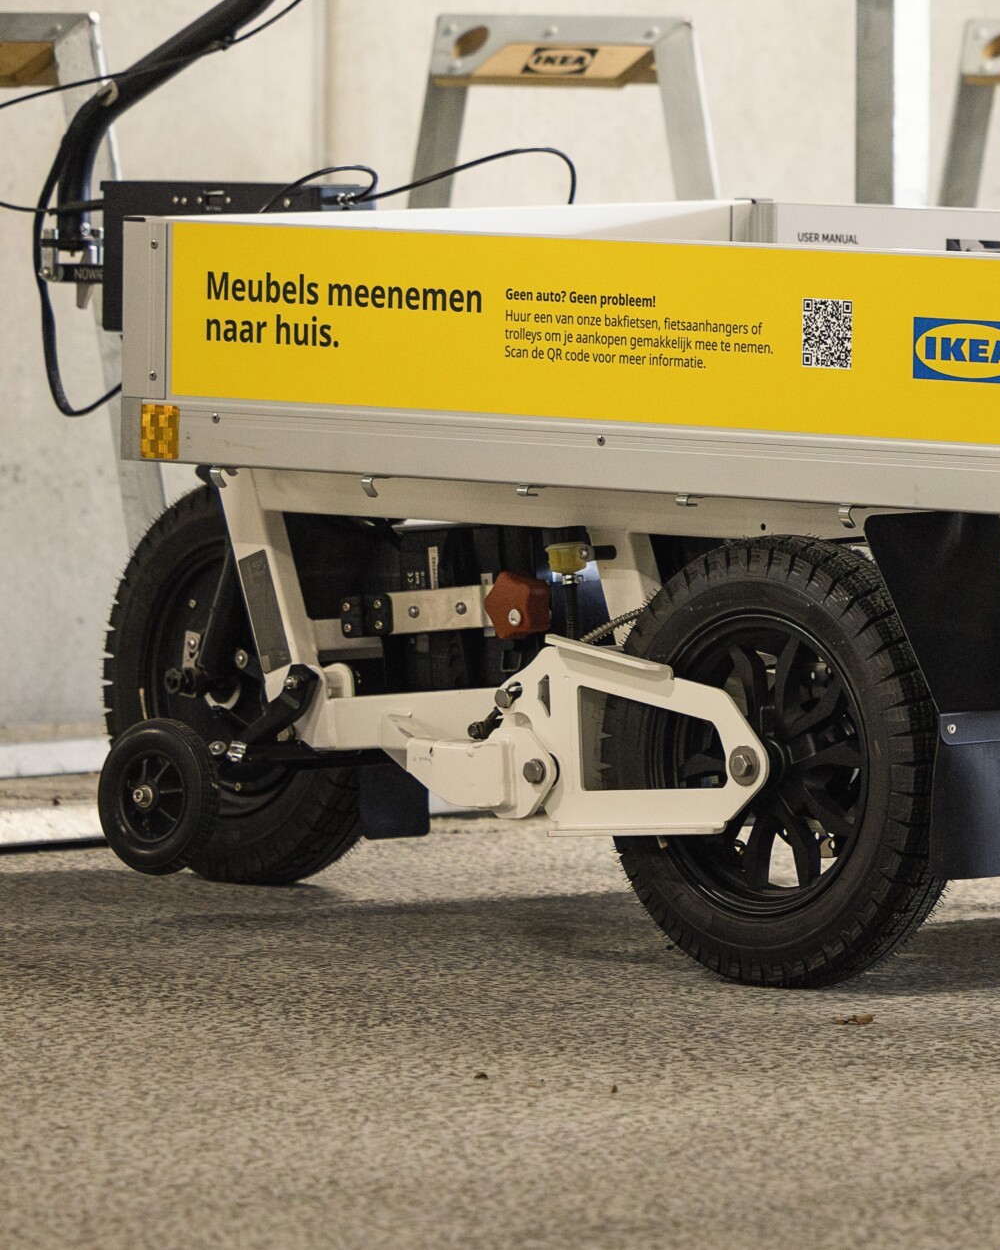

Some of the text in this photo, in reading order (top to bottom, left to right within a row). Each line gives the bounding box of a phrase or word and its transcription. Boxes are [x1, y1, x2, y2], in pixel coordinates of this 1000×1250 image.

[797, 232, 858, 245] USER MANUAL
[207, 271, 481, 313] Meubels meenemen
[506, 288, 655, 308] Geen auto? Geen probleem!
[207, 314, 338, 348] naar huis.
[506, 310, 762, 337] Huur een van onze bakfietsen, fietsaanhangers of
[505, 328, 773, 354] trolleys om je aankopen gemakkelijk mee te nemen.
[505, 345, 706, 368] Scan de QR code voor meer informatie.
